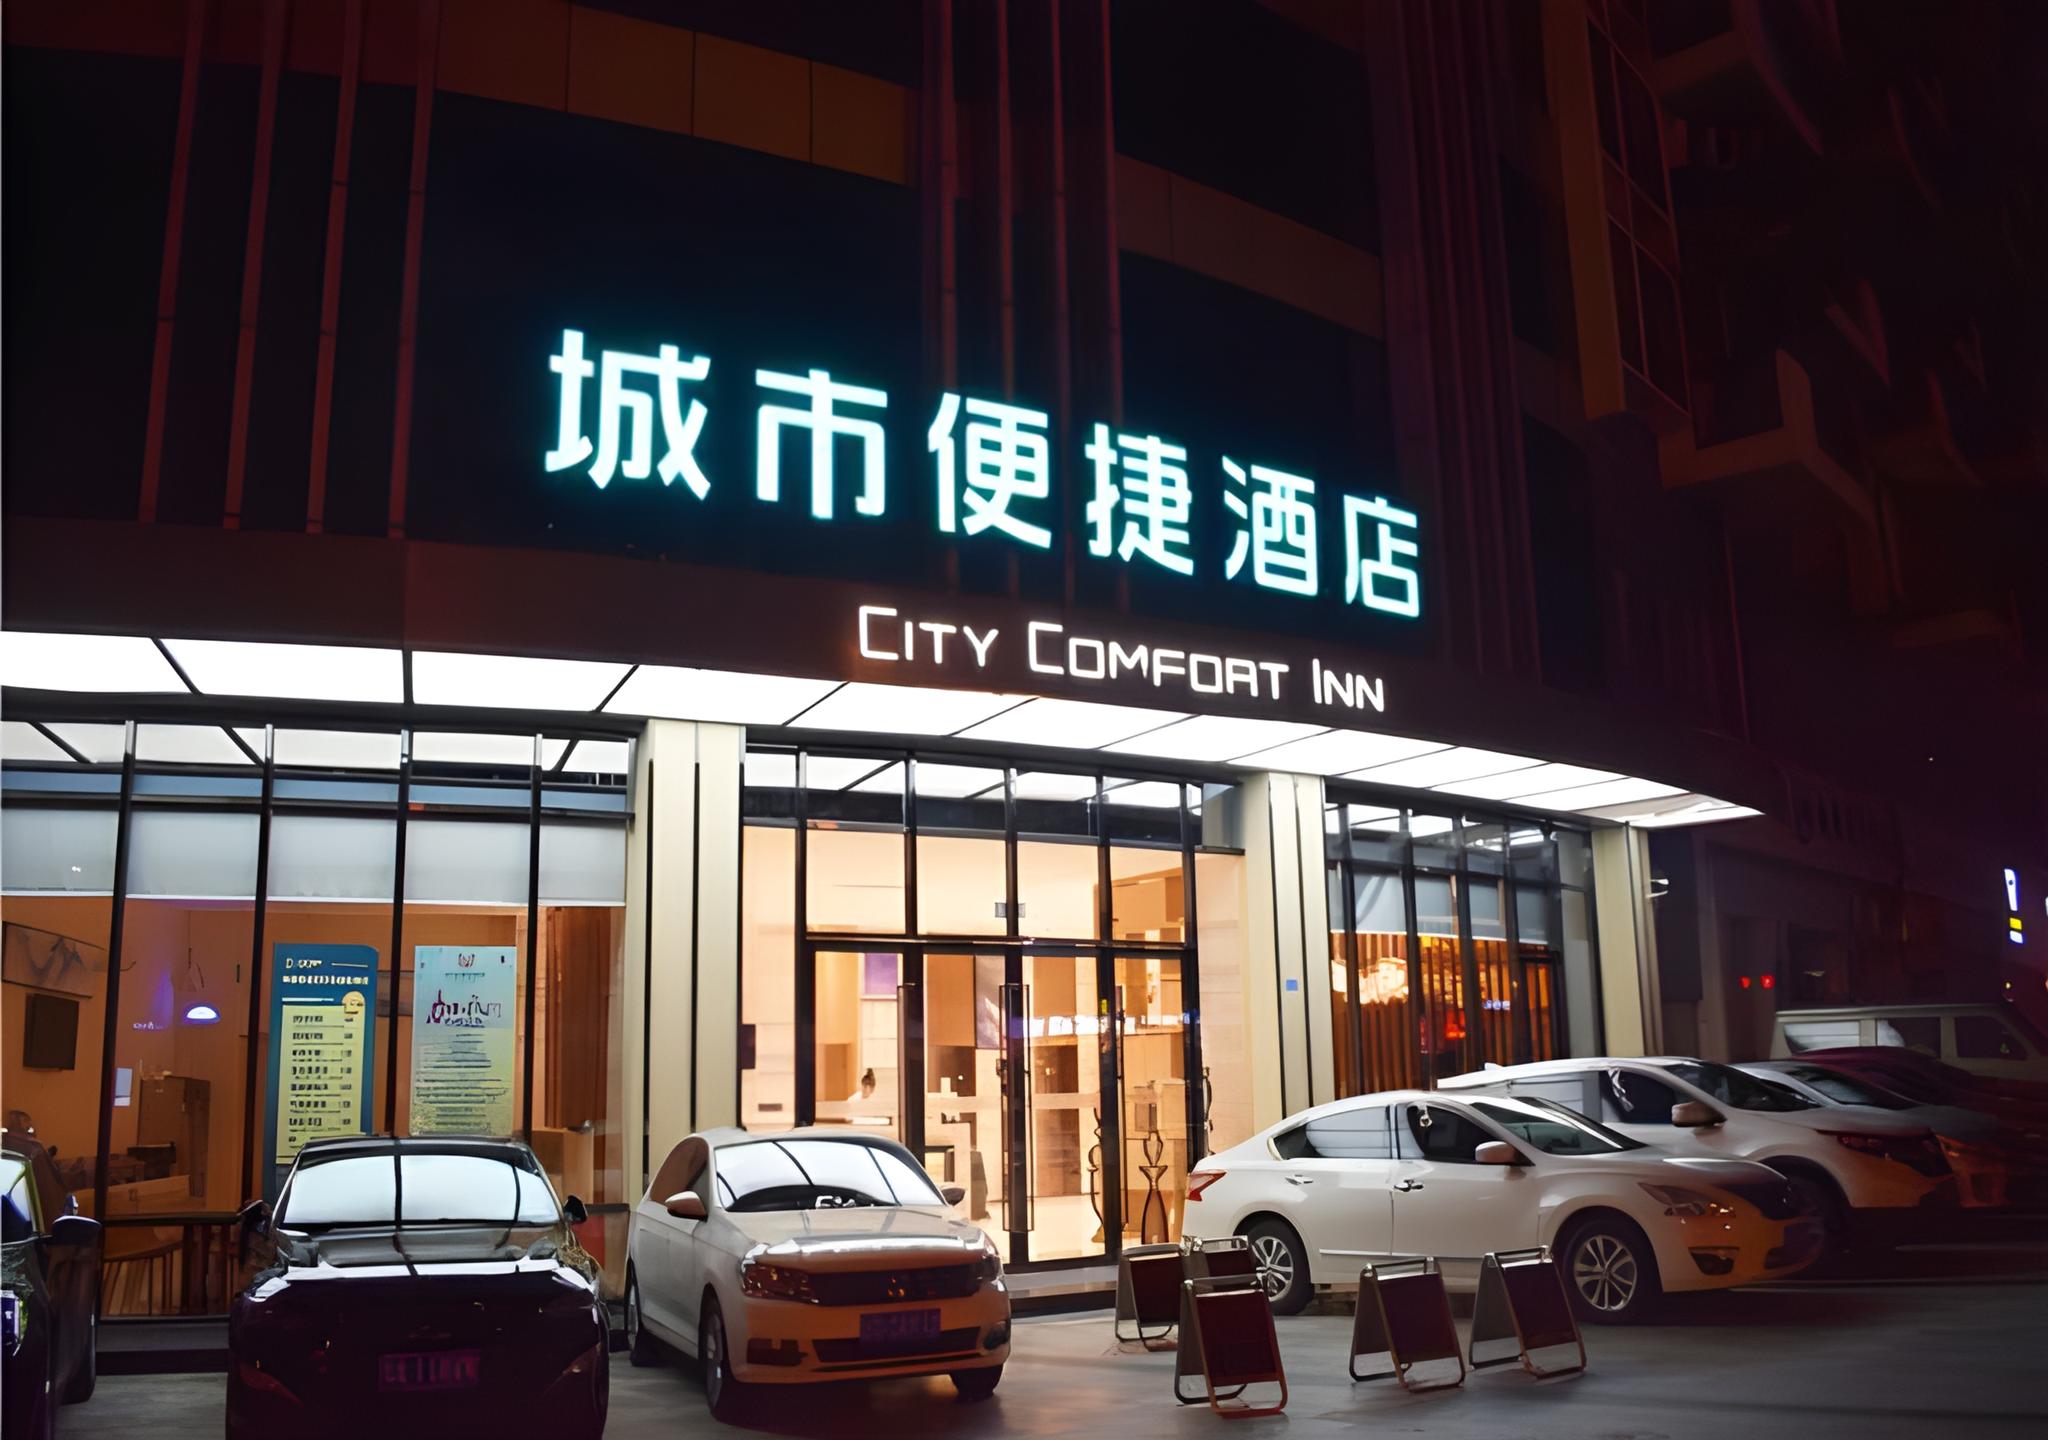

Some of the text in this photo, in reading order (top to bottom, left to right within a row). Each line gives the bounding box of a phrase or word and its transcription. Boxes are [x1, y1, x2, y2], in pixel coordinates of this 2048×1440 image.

[545, 329, 1420, 617] 城市便捷酒店
